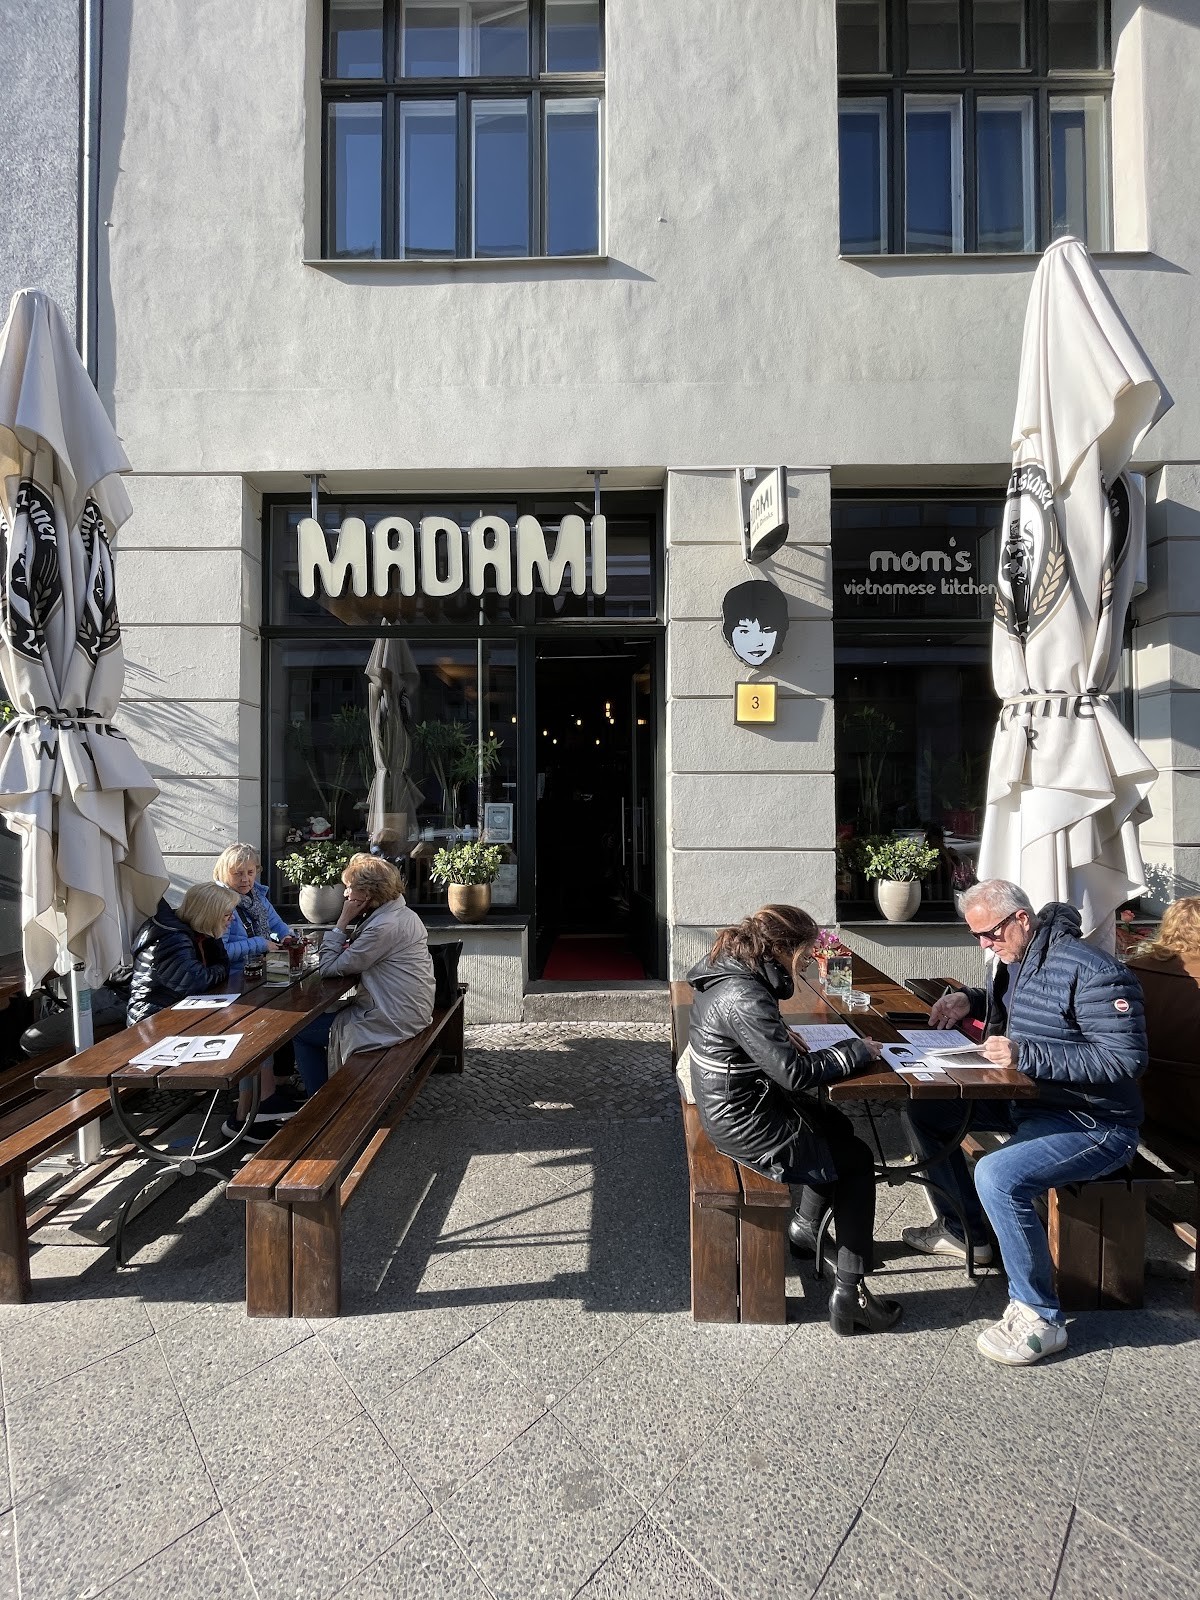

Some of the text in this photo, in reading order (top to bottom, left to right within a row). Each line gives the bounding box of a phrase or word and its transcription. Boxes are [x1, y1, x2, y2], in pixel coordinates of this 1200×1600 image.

[297, 514, 607, 598] MADAMI
[869, 536, 972, 572] mom's
[843, 577, 998, 595] vietnamese kitchen
[751, 696, 760, 709] 3
